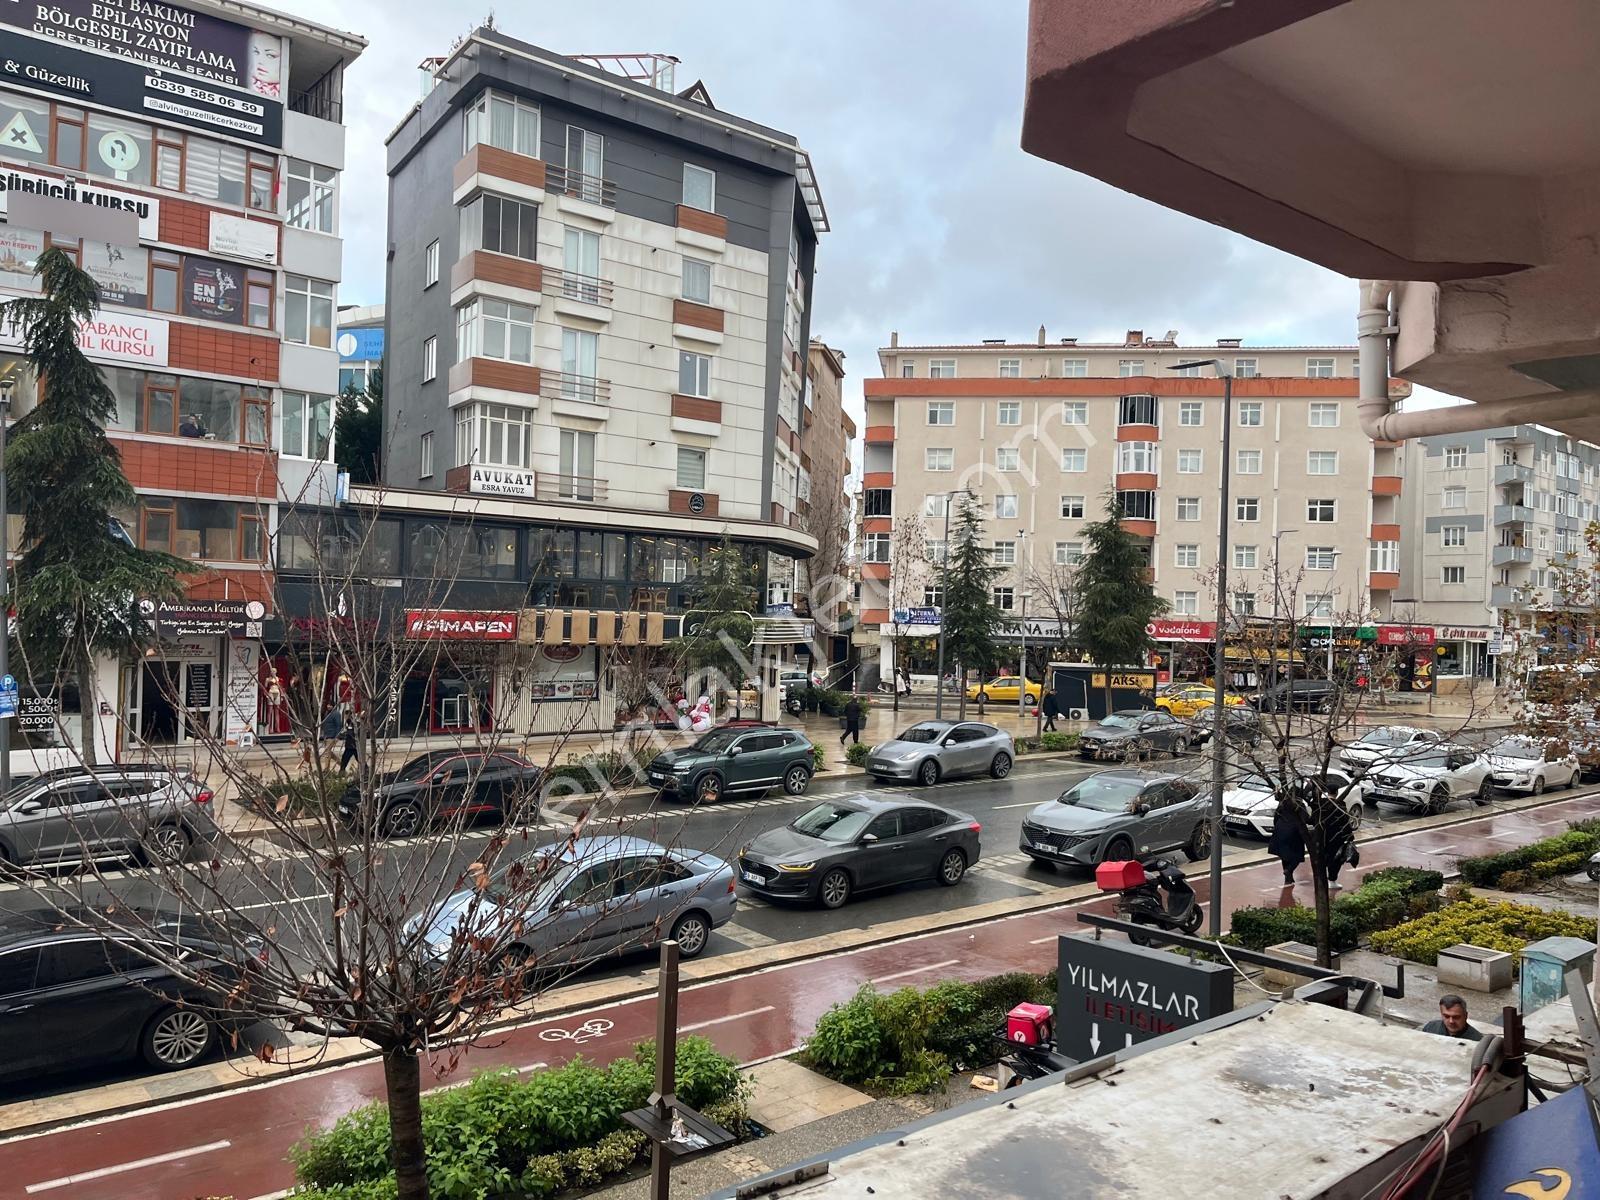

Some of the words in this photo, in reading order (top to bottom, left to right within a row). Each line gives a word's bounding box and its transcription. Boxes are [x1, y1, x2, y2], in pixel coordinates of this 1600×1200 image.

[130, 0, 196, 28] BAKIMI
[36, 4, 132, 44] BÖLGESEL
[136, 33, 236, 72] ZAYIFLAMA
[4, 60, 20, 73] &
[25, 65, 91, 92] Güzellik
[186, 65, 239, 85] SEANSI
[150, 78, 186, 94] 0539
[190, 87, 215, 102] 585
[218, 96, 236, 108] 06
[241, 103, 258, 114] 59
[193, 282, 216, 298] EN
[78, 319, 148, 342] YABANCI
[101, 338, 154, 357] KURSU
[473, 469, 533, 486] AVUKAT
[482, 484, 500, 492] ESRA
[502, 486, 525, 494] YAVUZ
[1158, 625, 1201, 635] vodafone
[4, 677, 12, 689] P
[1110, 674, 1139, 687] AKS
[1068, 962, 1199, 1021] YILMAZLAR
